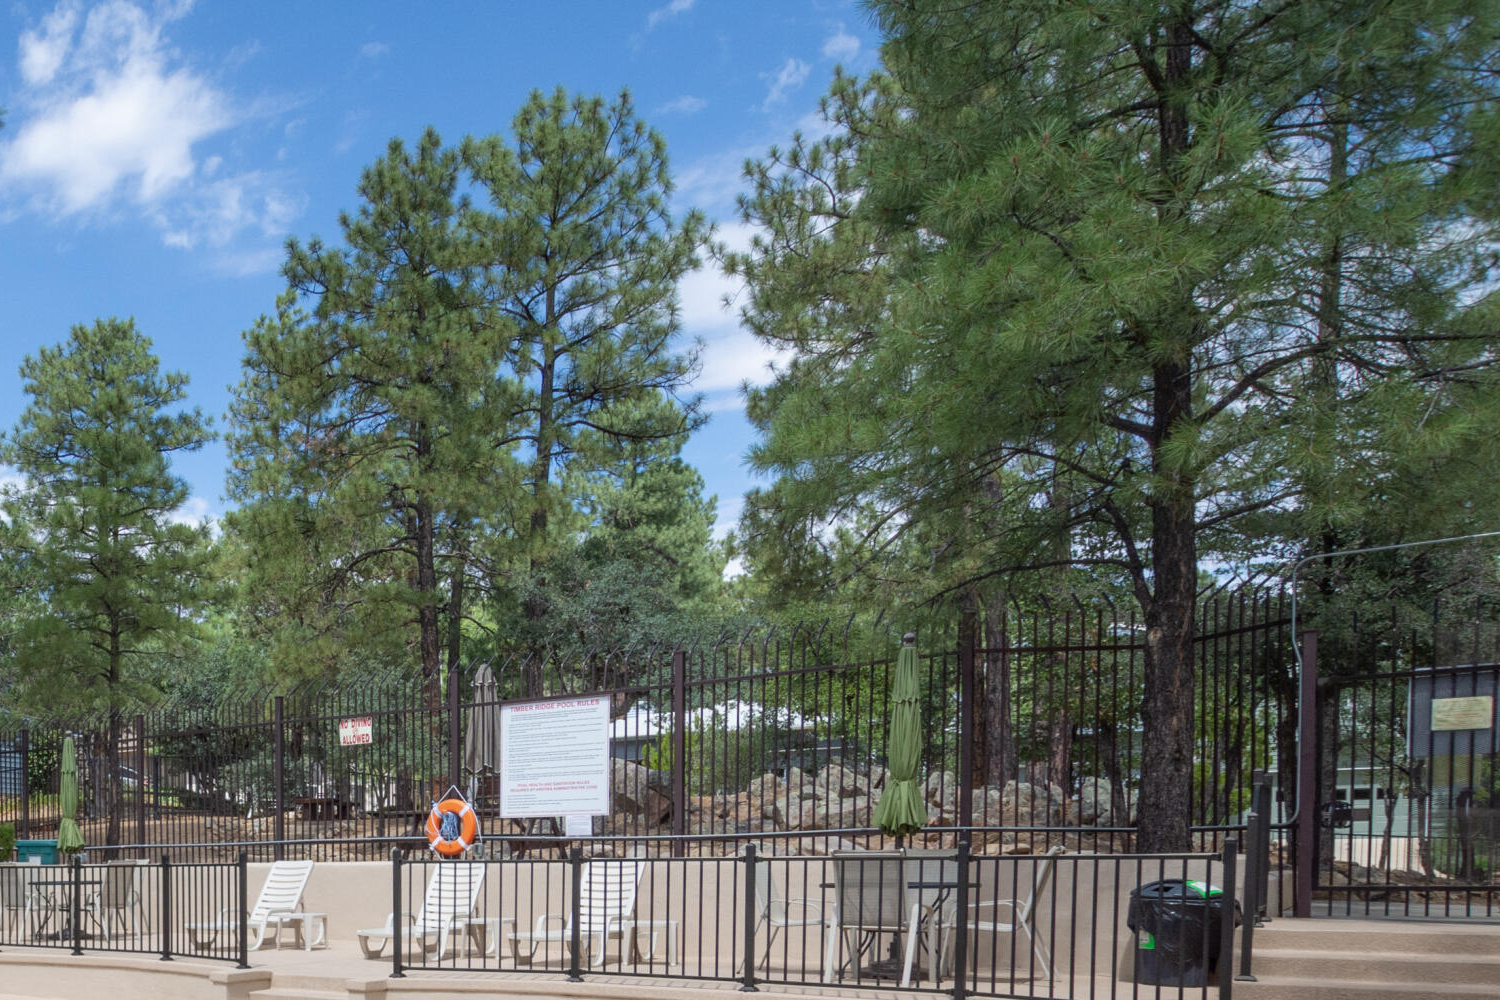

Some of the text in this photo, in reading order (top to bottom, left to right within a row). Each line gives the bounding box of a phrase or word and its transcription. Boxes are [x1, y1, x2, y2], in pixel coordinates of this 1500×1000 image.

[511, 704, 533, 712] TIMBER
[535, 702, 554, 711] RIDGE
[577, 698, 600, 706] RULES
[340, 716, 372, 729] NO DIVING
[343, 733, 370, 744] ALLOWED
